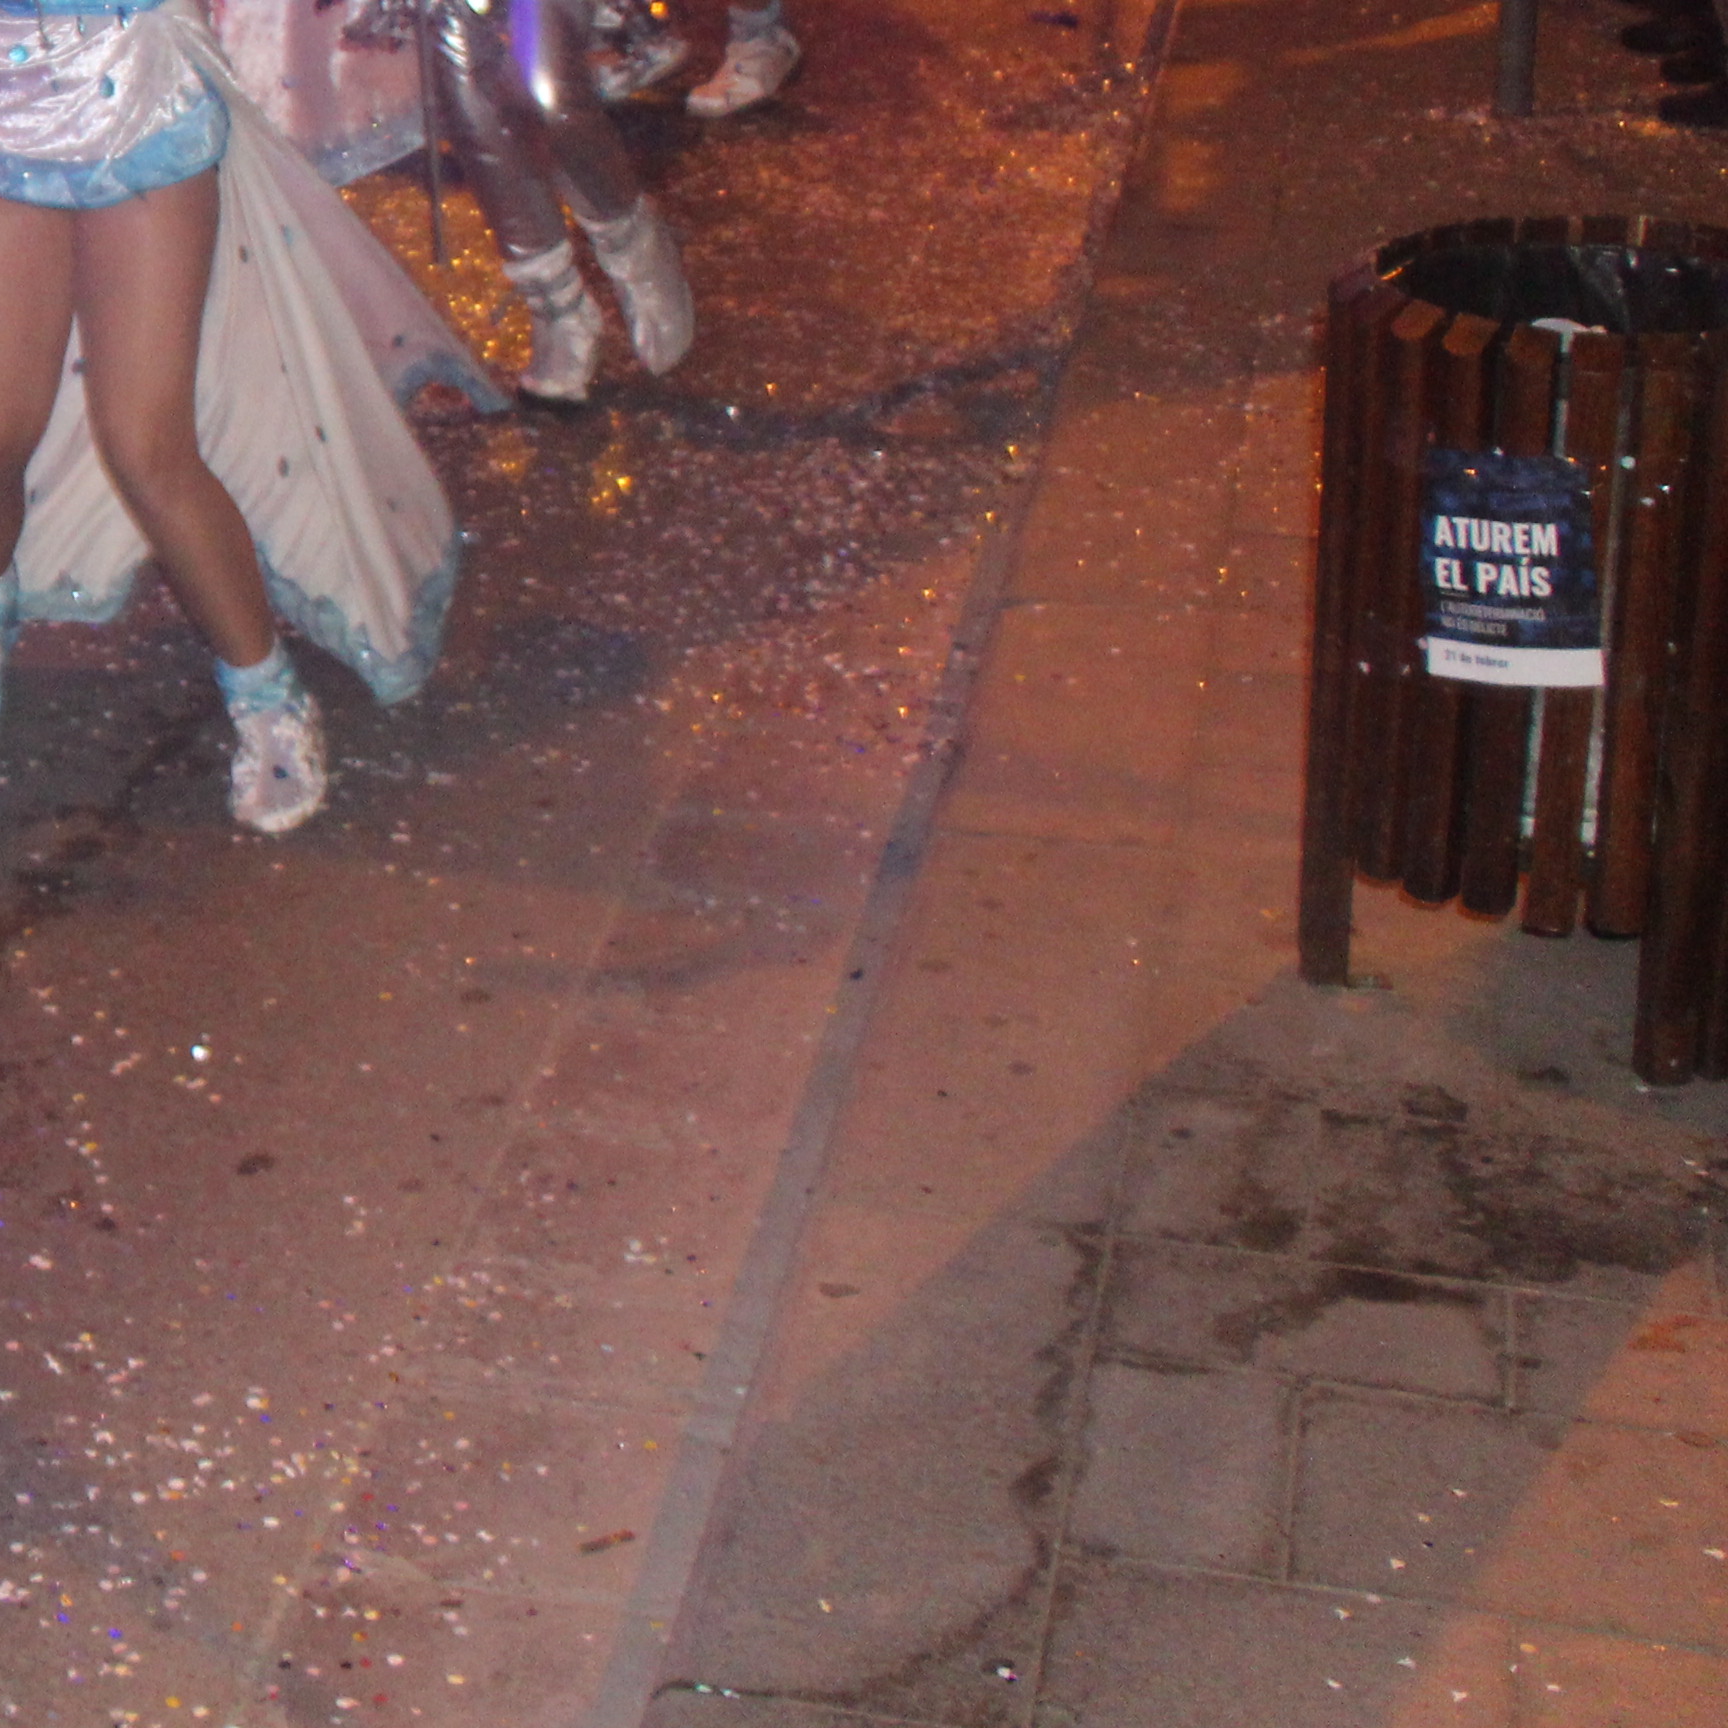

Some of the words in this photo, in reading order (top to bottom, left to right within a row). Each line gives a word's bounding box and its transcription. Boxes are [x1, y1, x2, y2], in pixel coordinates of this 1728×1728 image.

[1434, 515, 1561, 557] ATUREM
[1434, 556, 1470, 591] EL
[1475, 556, 1553, 597] PAÍS
